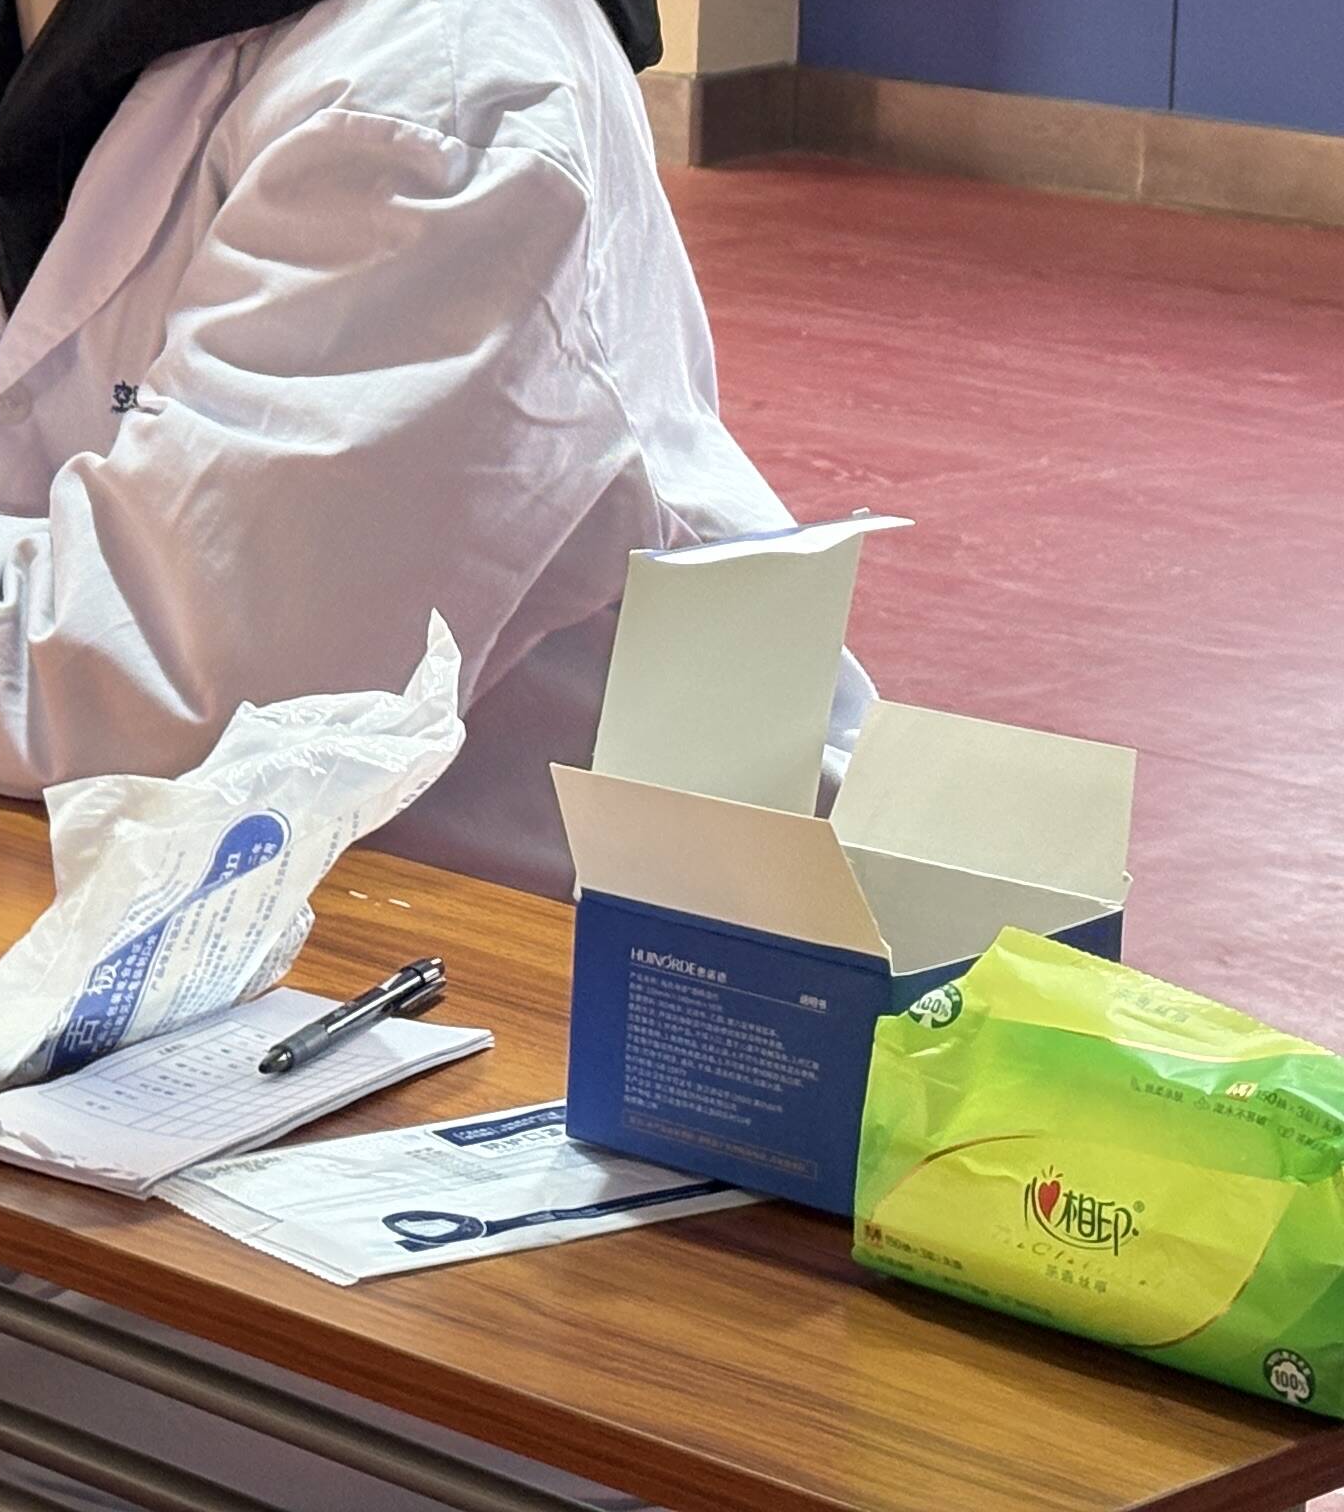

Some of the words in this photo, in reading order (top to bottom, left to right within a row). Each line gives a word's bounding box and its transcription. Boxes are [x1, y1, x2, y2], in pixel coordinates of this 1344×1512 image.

[1023, 1165, 1141, 1257] 心相印
[1274, 1369, 1308, 1396] 100%
